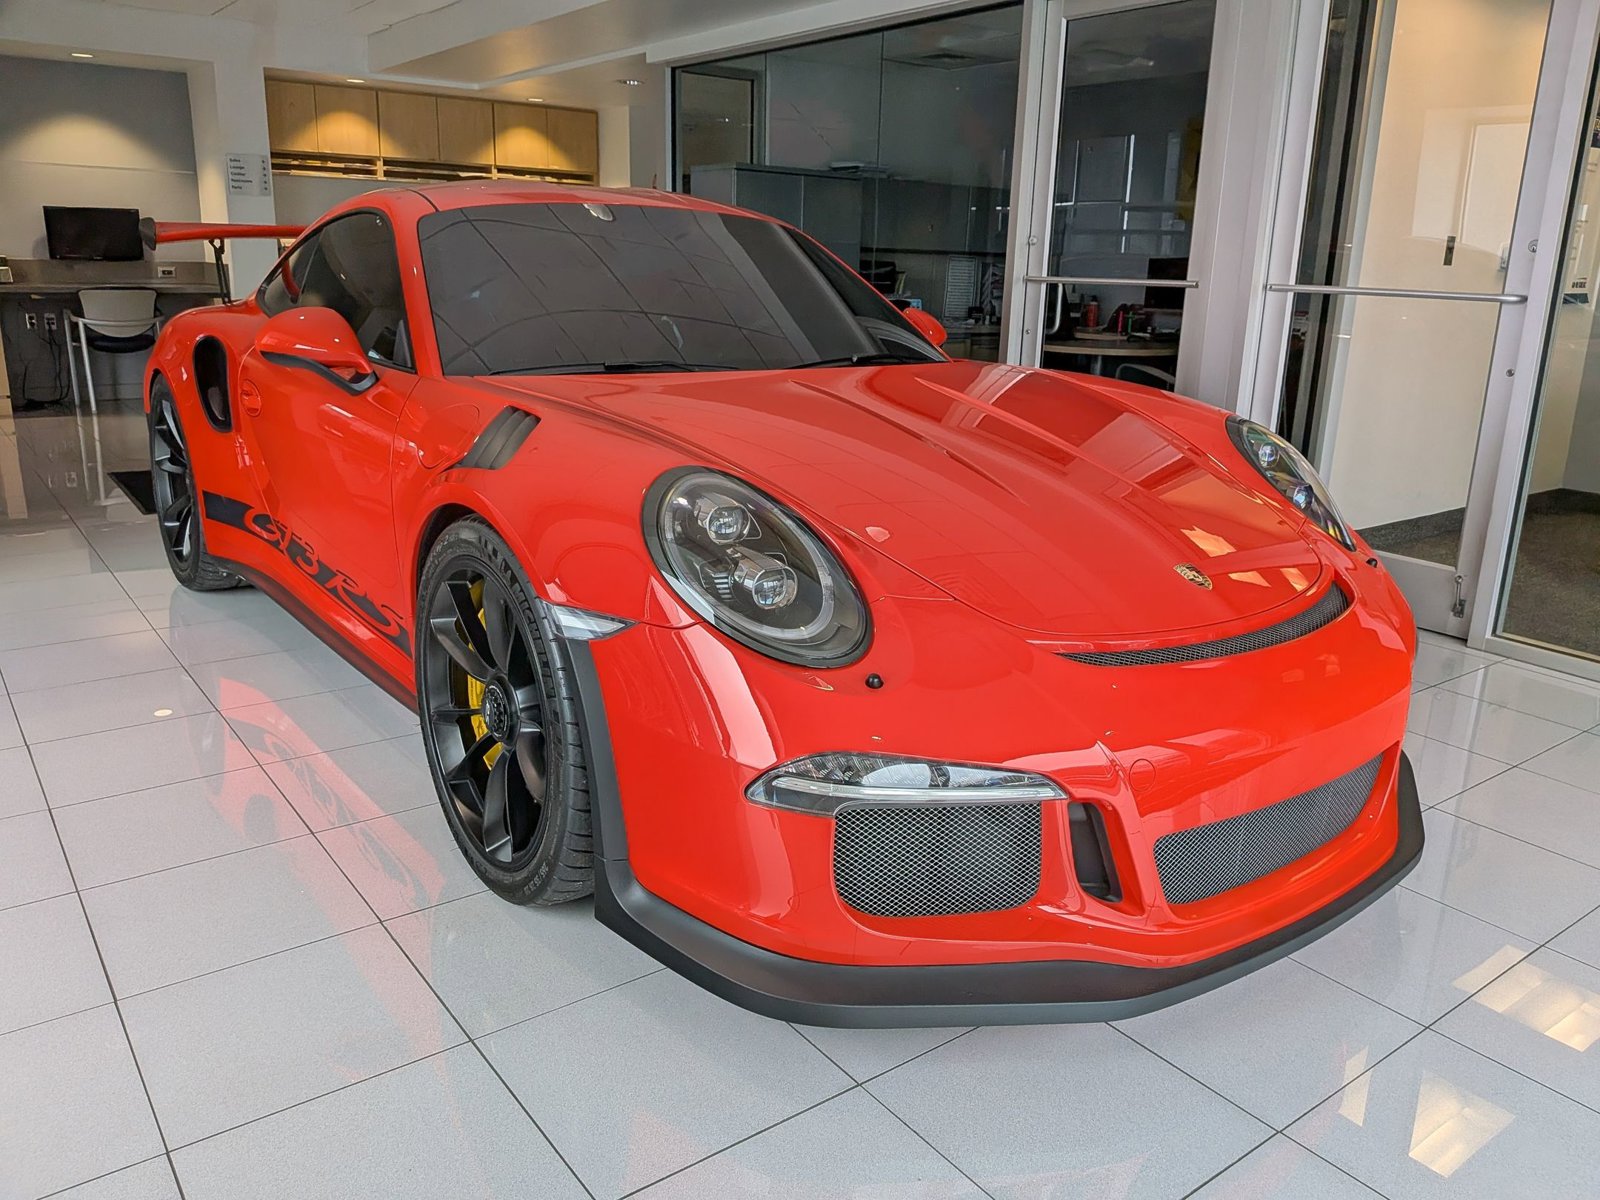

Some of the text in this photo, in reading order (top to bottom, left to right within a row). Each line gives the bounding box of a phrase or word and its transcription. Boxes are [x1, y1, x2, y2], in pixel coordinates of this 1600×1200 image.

[244, 508, 404, 638] GT3 RS
[511, 582, 556, 699] MICHELIN
